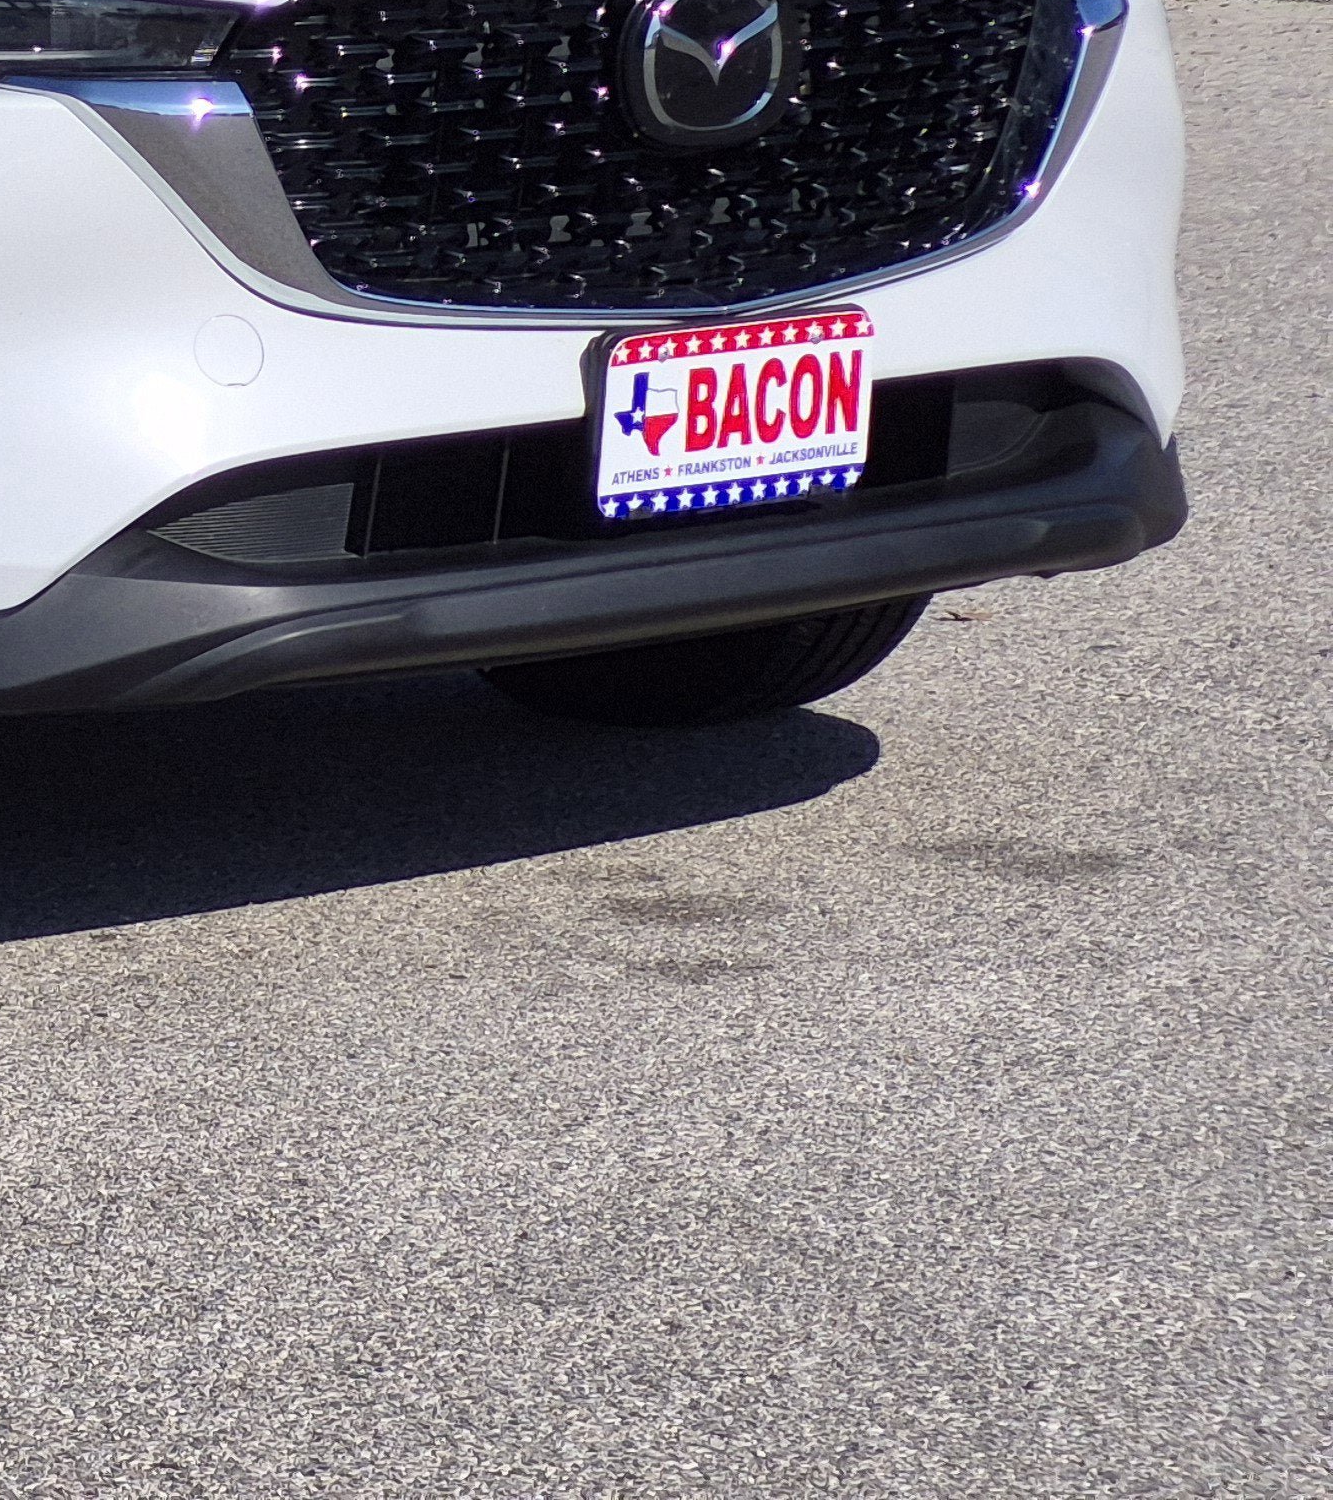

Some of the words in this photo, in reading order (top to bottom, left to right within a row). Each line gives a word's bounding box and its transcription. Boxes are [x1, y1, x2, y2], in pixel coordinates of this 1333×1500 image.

[685, 350, 863, 452] BACON
[612, 467, 660, 485] ATHENS
[678, 455, 752, 477] FRANKSTON
[769, 442, 858, 465] JACKSONVILLE
